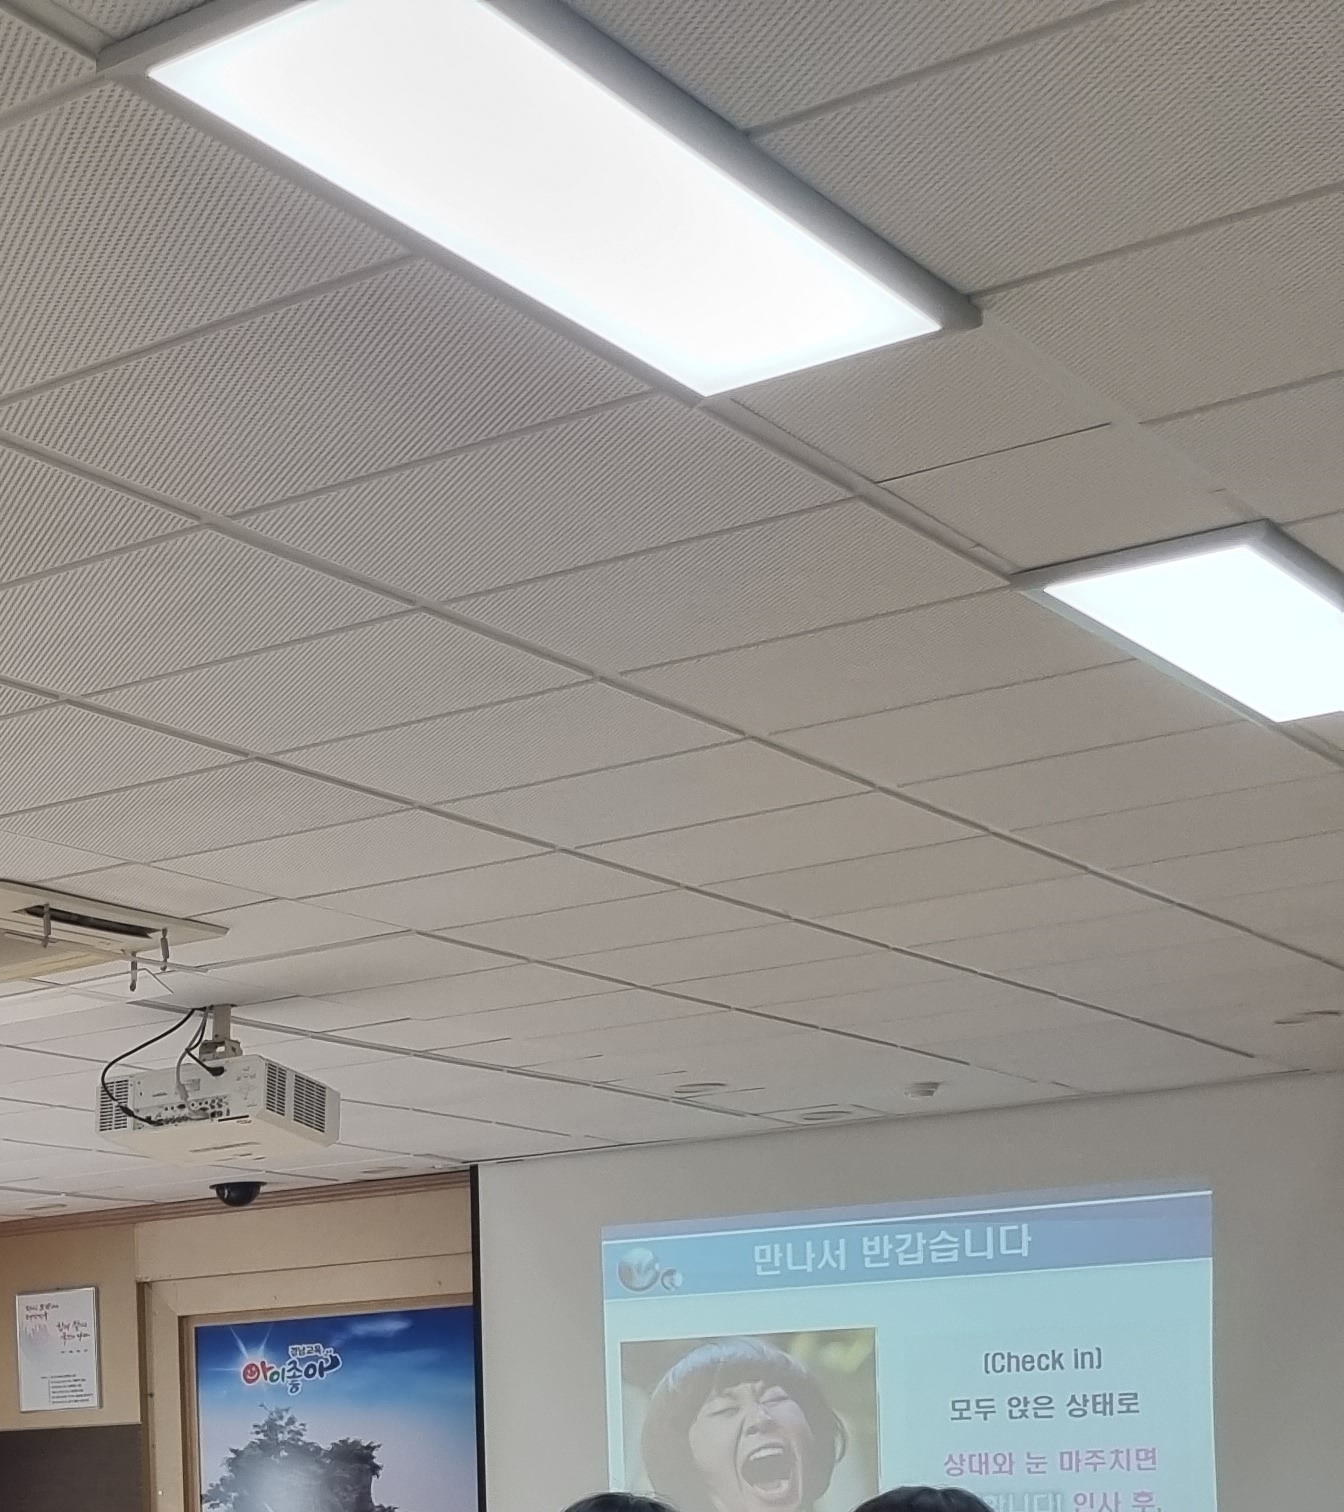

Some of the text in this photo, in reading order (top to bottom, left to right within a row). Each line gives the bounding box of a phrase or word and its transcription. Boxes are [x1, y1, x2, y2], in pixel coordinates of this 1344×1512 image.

[754, 1224, 1032, 1277] 만나서 반갑습니다
[241, 1353, 342, 1395] 아이좋아
[950, 1392, 1140, 1421] 모두 앉은 상태로
[944, 1447, 1157, 1477] 상대와 눈 마주치면
